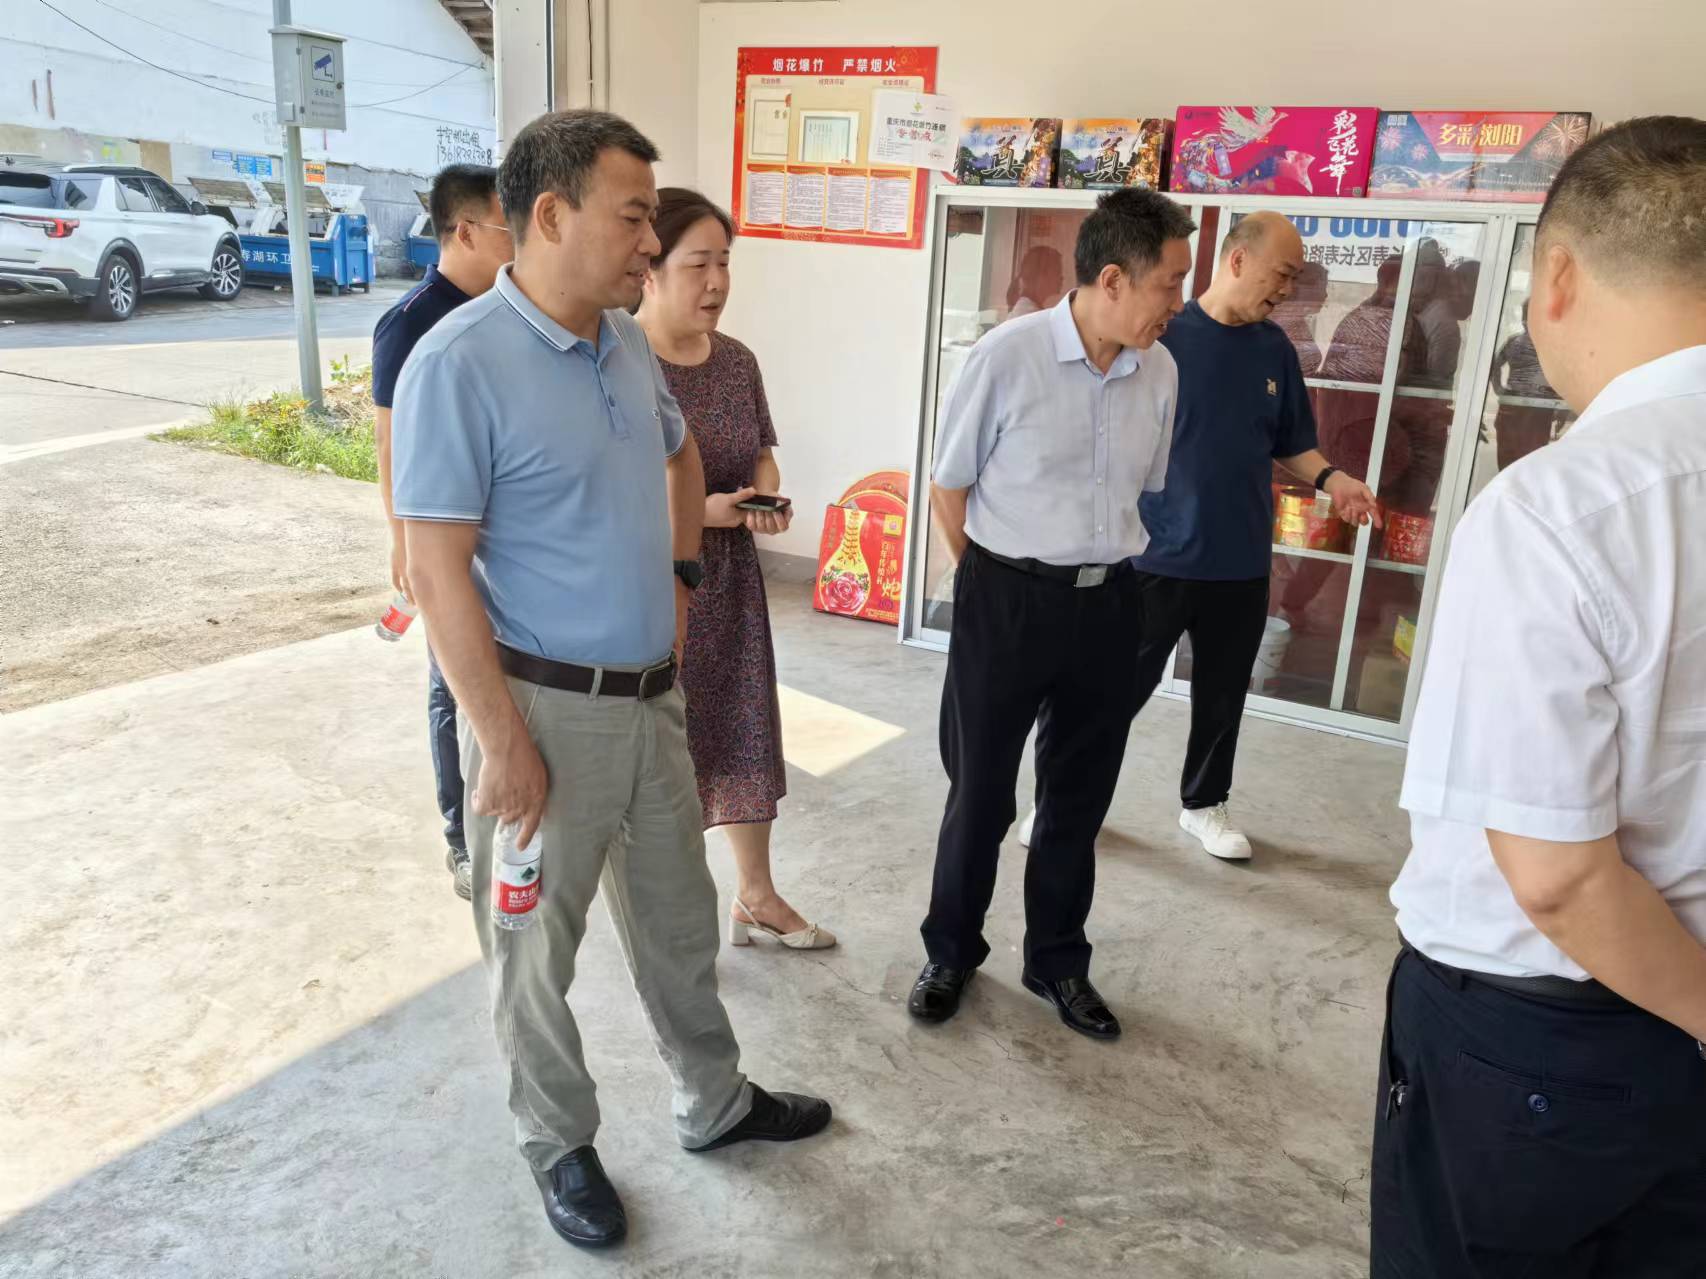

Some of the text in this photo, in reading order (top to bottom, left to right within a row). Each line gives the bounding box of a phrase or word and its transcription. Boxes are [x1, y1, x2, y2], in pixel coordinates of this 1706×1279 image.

[773, 58, 897, 73] 烟花爆竹 严禁烟火
[1437, 122, 1522, 147] 多彩浏阳
